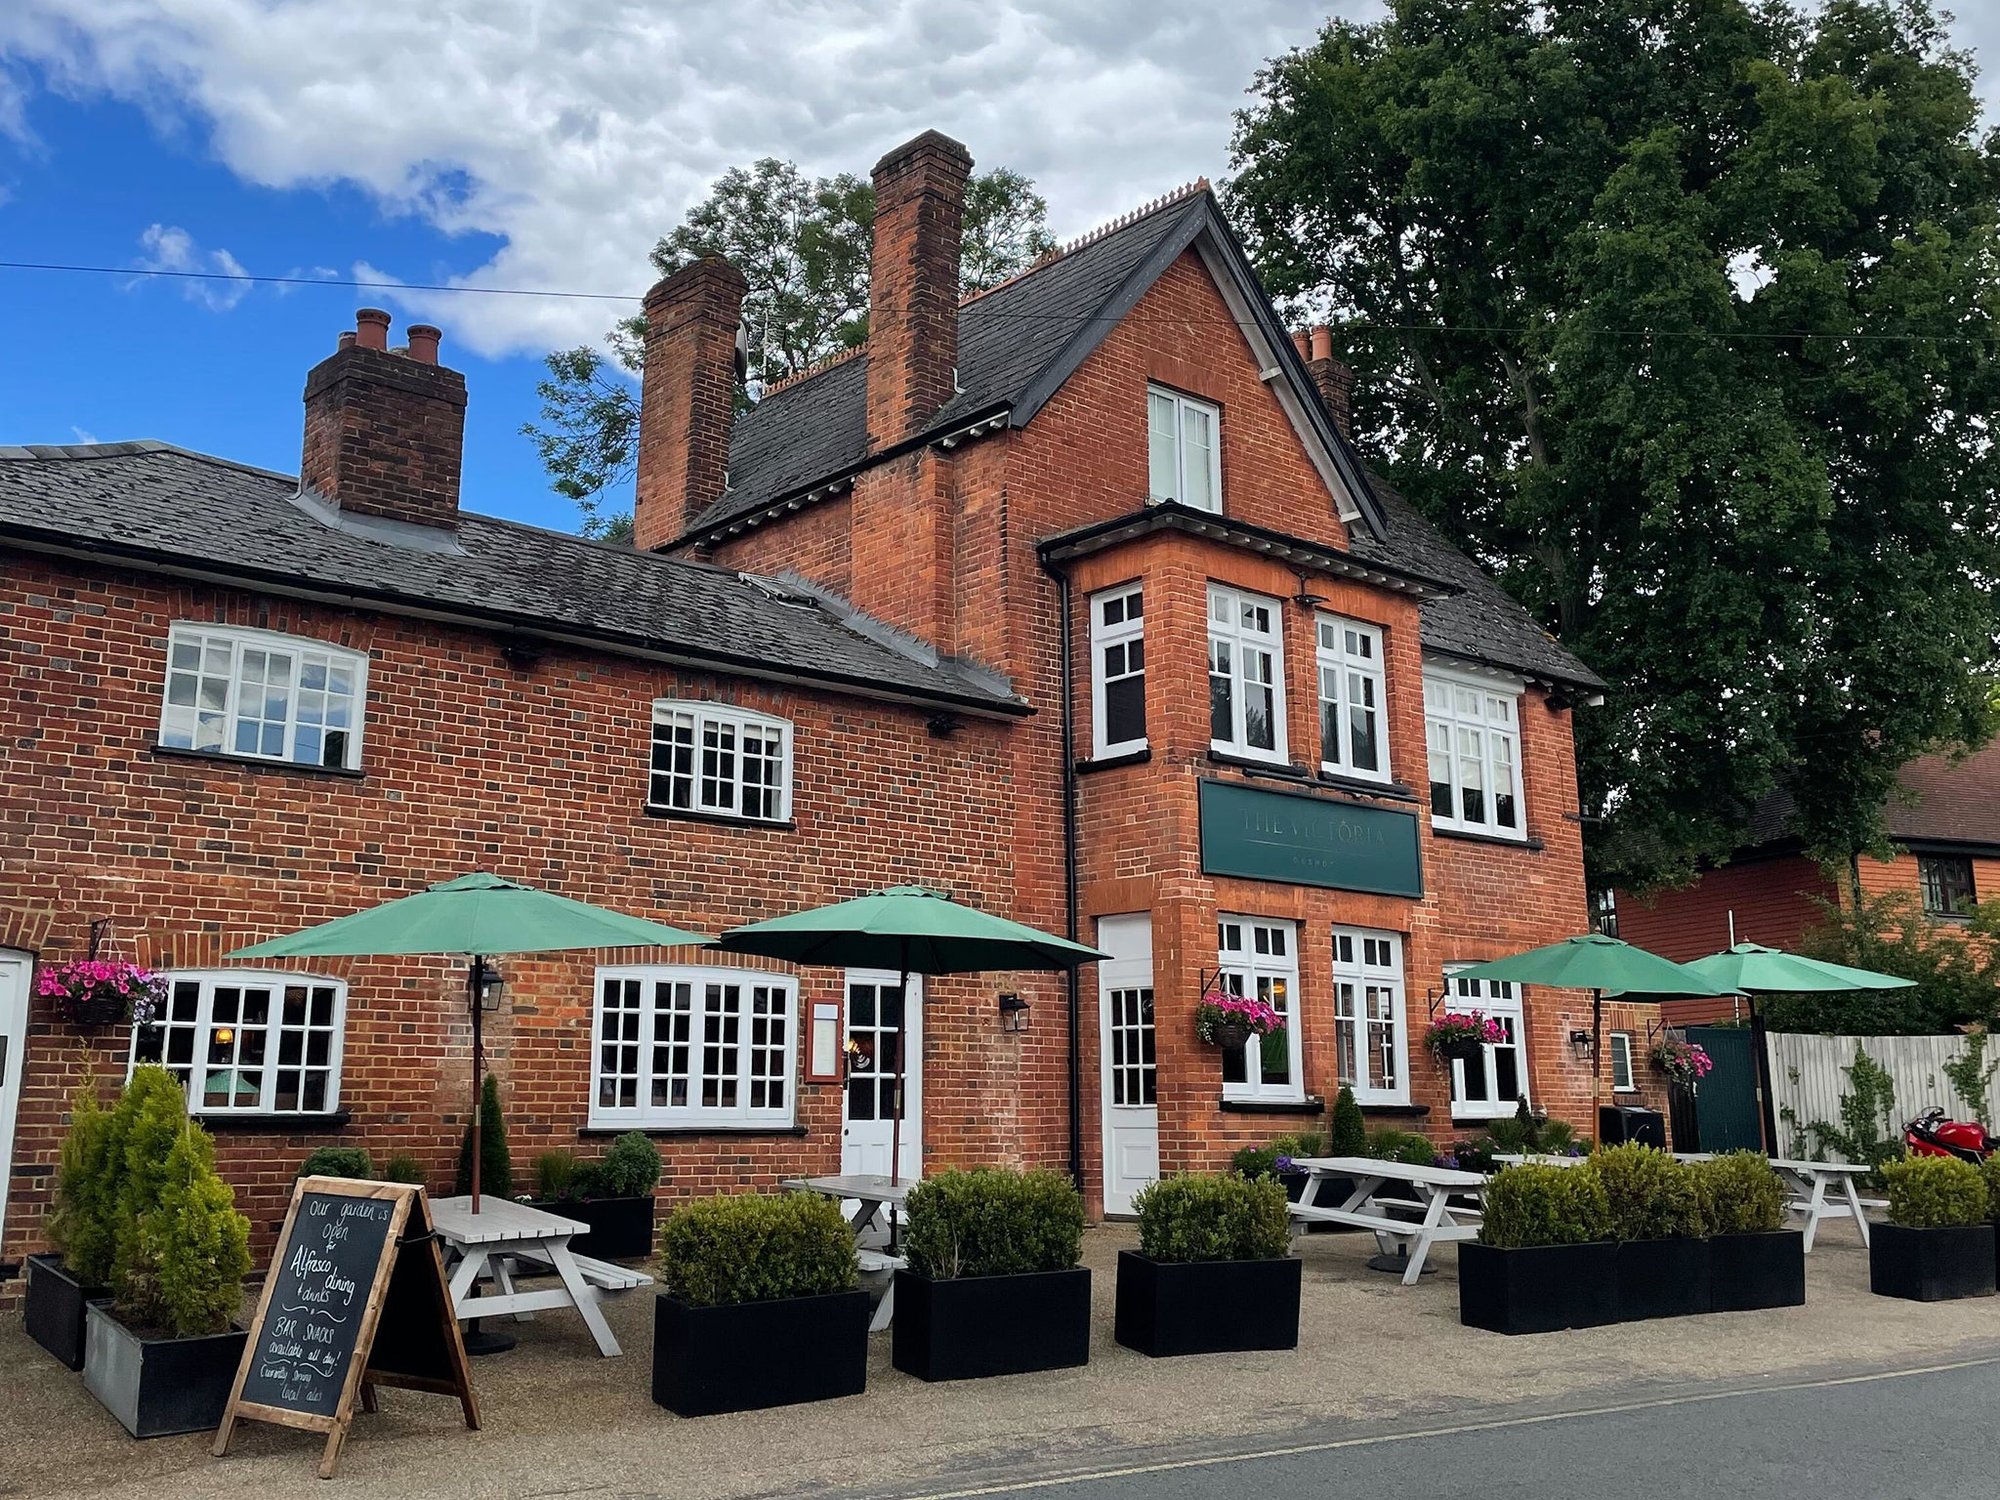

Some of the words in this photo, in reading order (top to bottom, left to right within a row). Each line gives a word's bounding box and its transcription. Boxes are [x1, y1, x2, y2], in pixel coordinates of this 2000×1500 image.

[1240, 808, 1284, 834] THE
[309, 1200, 331, 1216] Our
[337, 1202, 374, 1226] garden
[378, 1210, 388, 1220] is
[325, 1241, 337, 1254] for
[302, 1286, 331, 1302] drinks
[325, 1266, 355, 1306] dining
[271, 1316, 298, 1338] BAR
[302, 1323, 334, 1344] SNACKS
[268, 1340, 303, 1358] available
[307, 1349, 321, 1361] all
[281, 1384, 301, 1401] local
